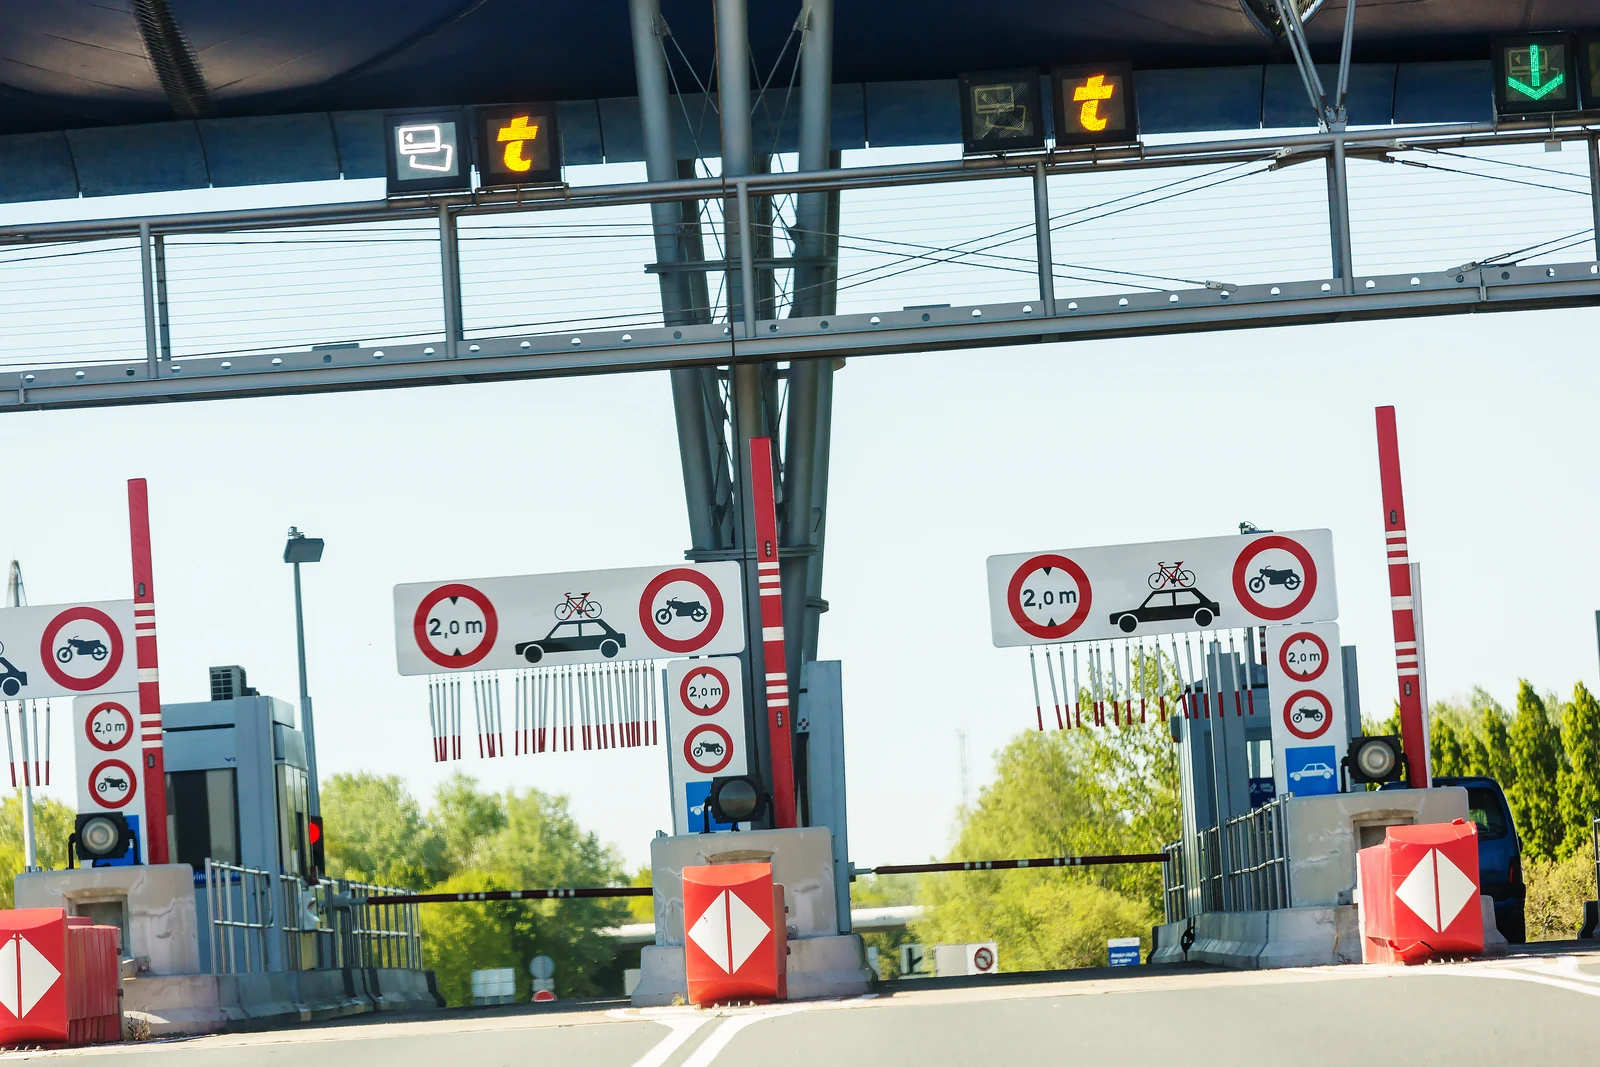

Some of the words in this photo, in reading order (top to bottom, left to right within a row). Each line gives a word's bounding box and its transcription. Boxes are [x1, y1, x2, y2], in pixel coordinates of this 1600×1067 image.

[1072, 75, 1114, 132] t
[496, 115, 539, 172] t
[1022, 588, 1054, 610] 2,0
[1058, 590, 1077, 605] m
[428, 617, 460, 639] 2,0
[465, 620, 483, 634] m
[1288, 651, 1307, 665] 2,0
[1309, 653, 1321, 662] m
[689, 686, 708, 700] 2,0
[710, 687, 721, 697] m
[93, 721, 112, 735] 2,0
[114, 723, 125, 732] m
